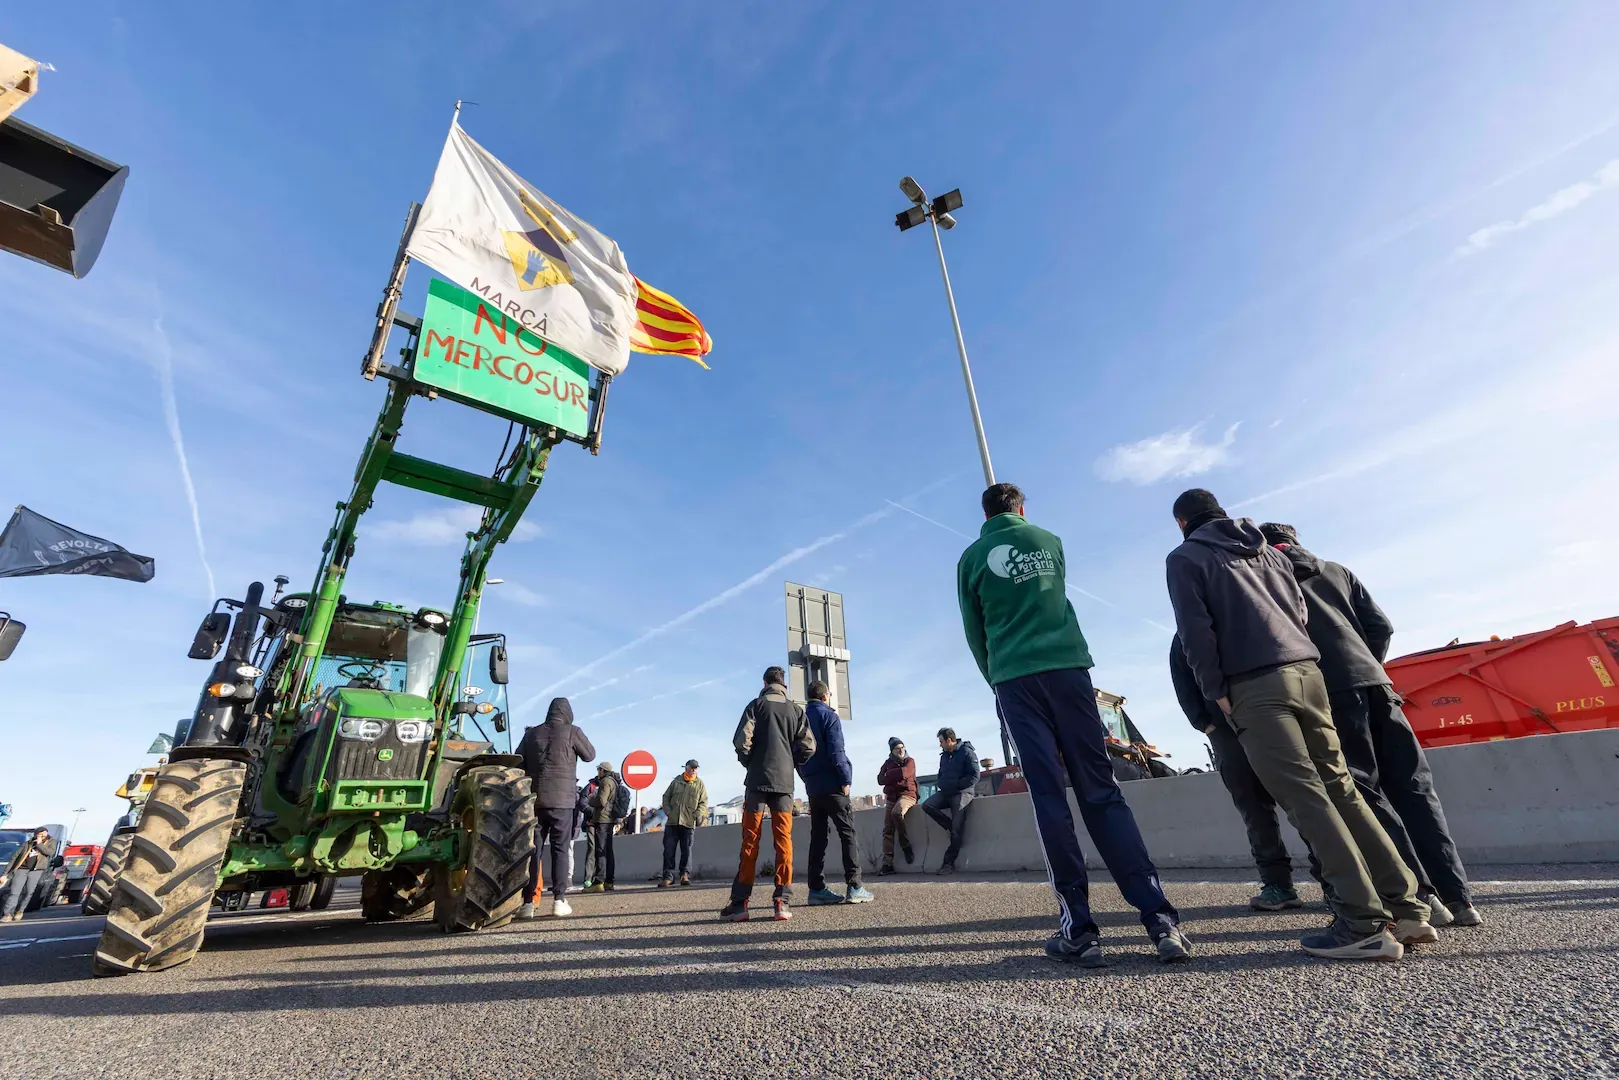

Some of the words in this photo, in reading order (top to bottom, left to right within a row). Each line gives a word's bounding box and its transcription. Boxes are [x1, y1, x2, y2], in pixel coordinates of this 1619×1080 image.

[470, 277, 548, 336] MARÇÀ
[474, 303, 548, 356] NO
[423, 329, 588, 412] MERCOSUR
[49, 540, 109, 552] REVOLTA
[1457, 714, 1473, 725] 45
[1556, 695, 1605, 713] PLUS
